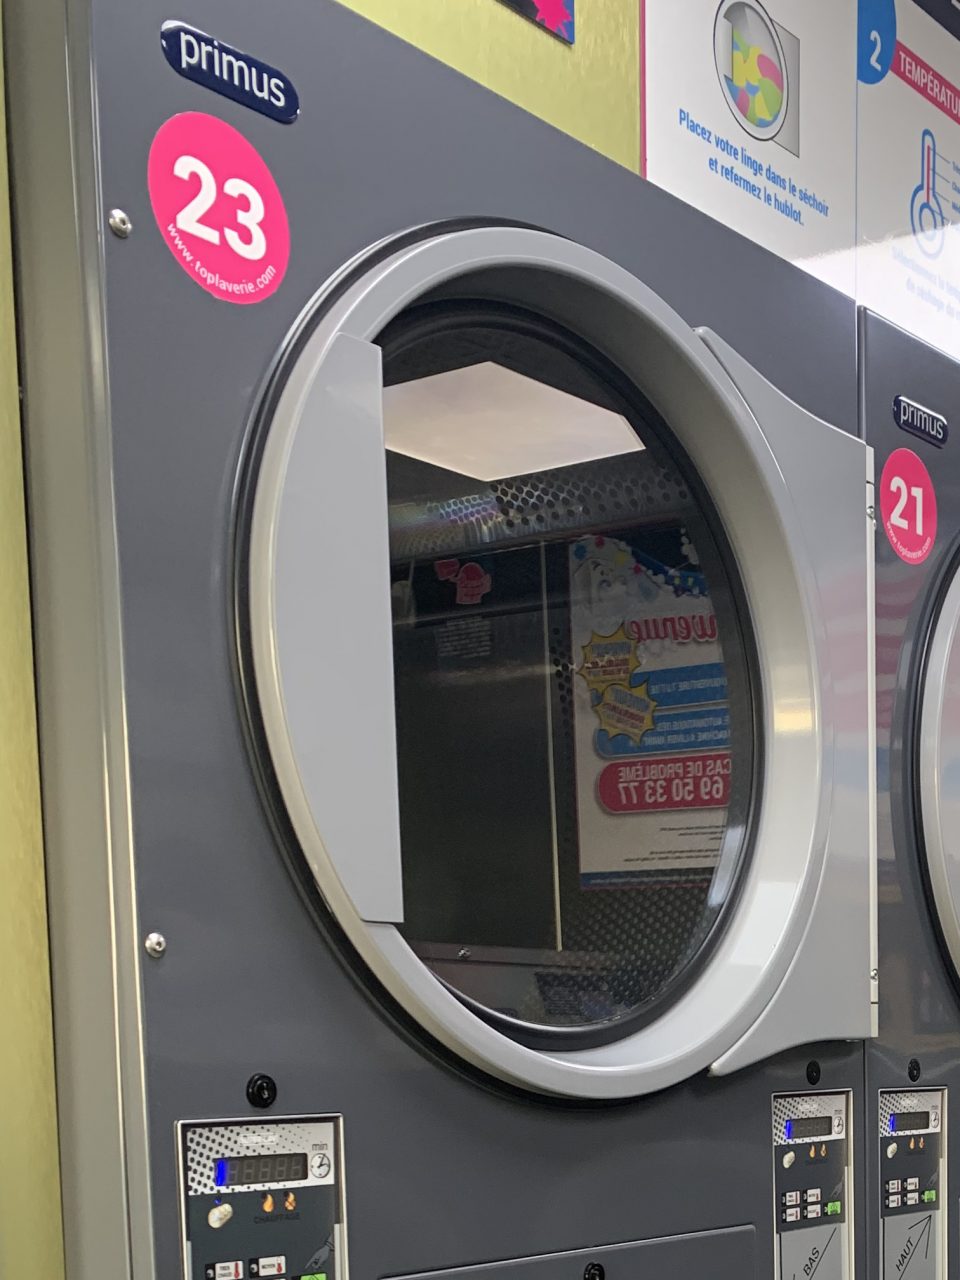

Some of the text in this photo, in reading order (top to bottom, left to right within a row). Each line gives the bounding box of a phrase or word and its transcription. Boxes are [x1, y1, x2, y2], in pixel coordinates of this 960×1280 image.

[179, 30, 286, 107] primus
[870, 30, 881, 71] 2
[678, 107, 829, 218] Placez votre linge dans le séchoir
[708, 157, 719, 174] et
[720, 164, 762, 201] refermez
[764, 189, 773, 207] le
[173, 155, 267, 260] 23
[167, 222, 277, 295] www.toplaverie.com
[900, 400, 944, 440] primus
[889, 475, 923, 537] 21
[803, 1247, 820, 1277] BAS
[894, 1237, 914, 1272] HAUT
